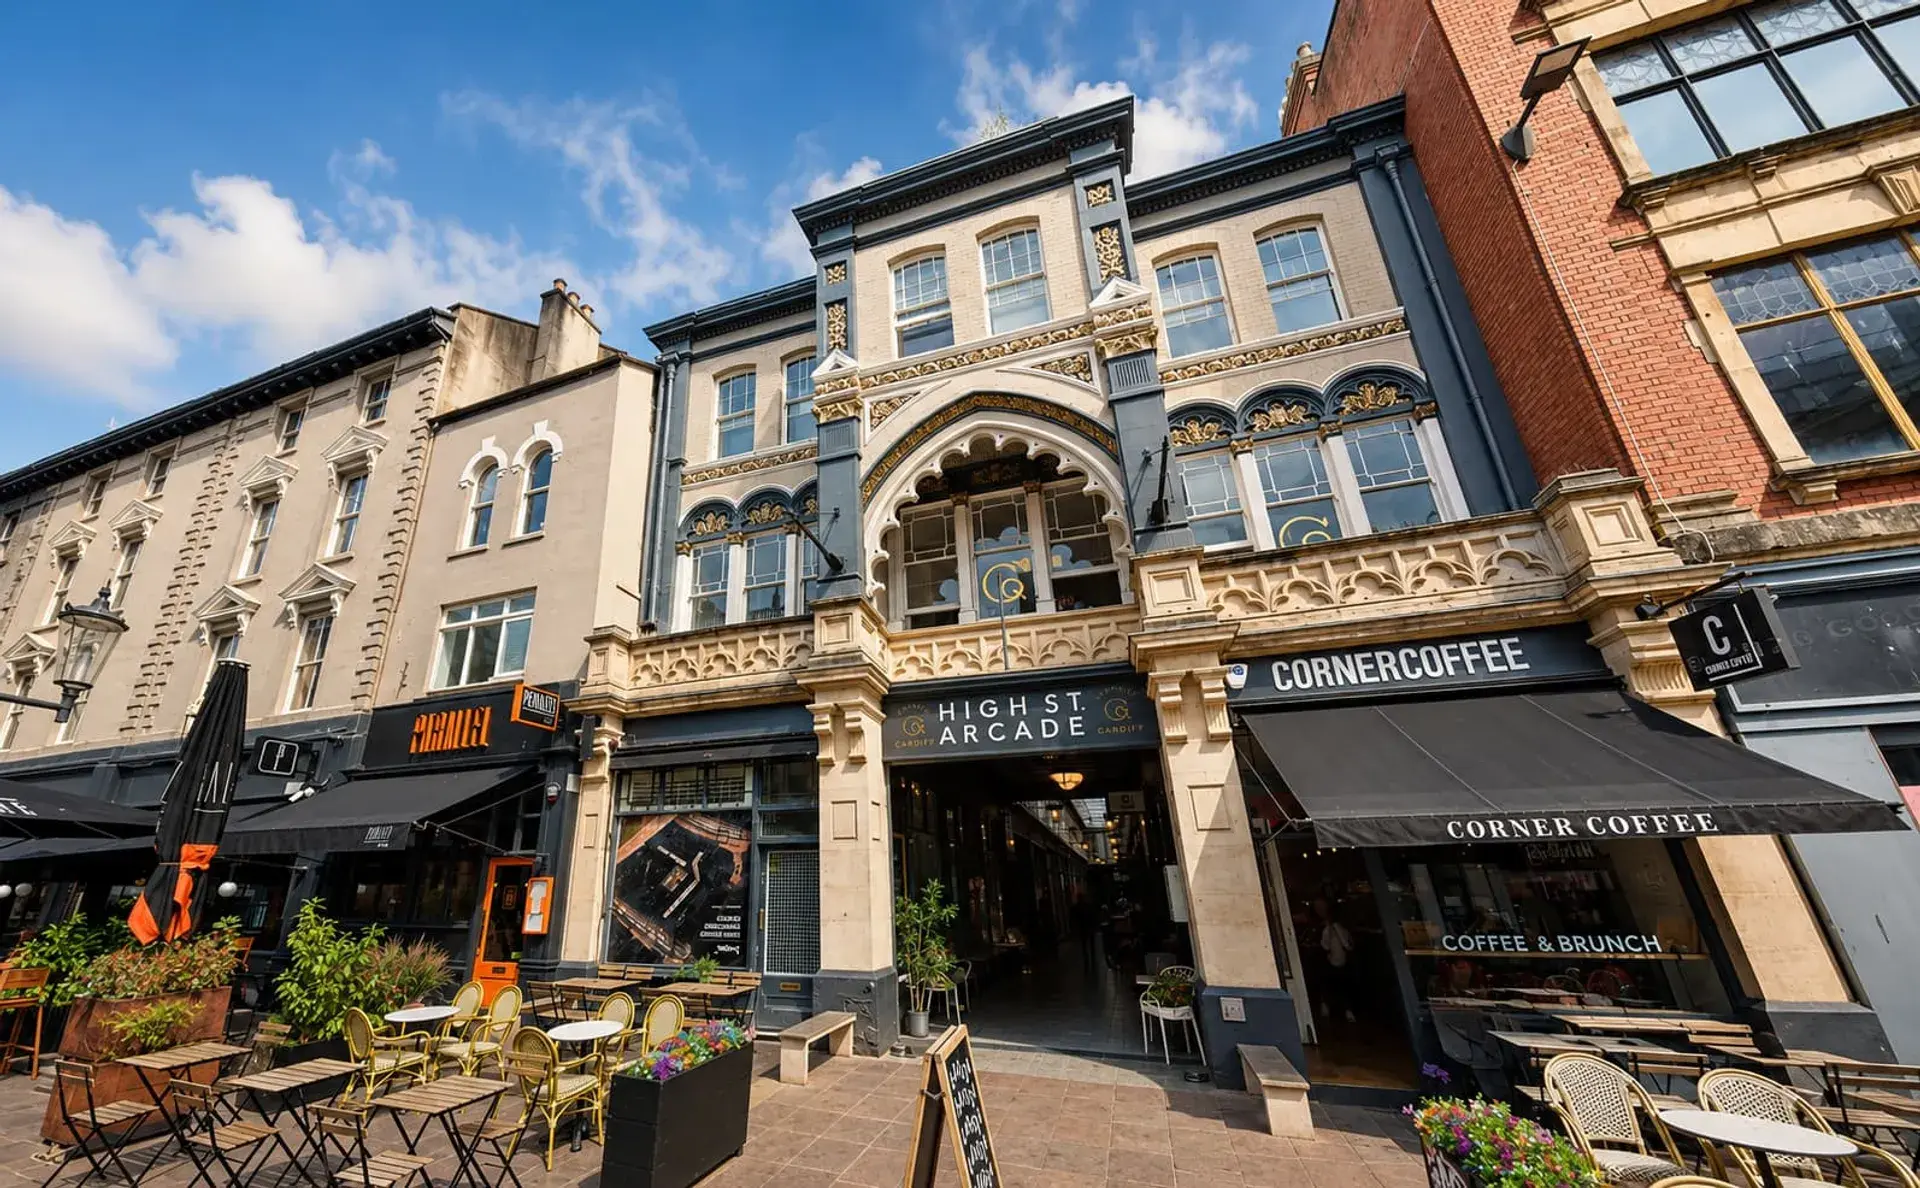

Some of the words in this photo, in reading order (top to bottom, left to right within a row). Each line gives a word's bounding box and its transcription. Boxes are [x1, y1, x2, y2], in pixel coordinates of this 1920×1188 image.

[1702, 615, 1731, 656] C
[1271, 637, 1531, 692] CORNERCOFFEE
[939, 696, 1027, 722] HIGH
[1044, 692, 1086, 713] ST.
[939, 716, 1086, 746] ARCADE
[1446, 816, 1578, 840] CORNER
[1586, 812, 1720, 836] COFFEE
[1442, 934, 1529, 952] COFFEE
[1538, 935, 1554, 952] &
[1557, 934, 1663, 953] BRUNCH
